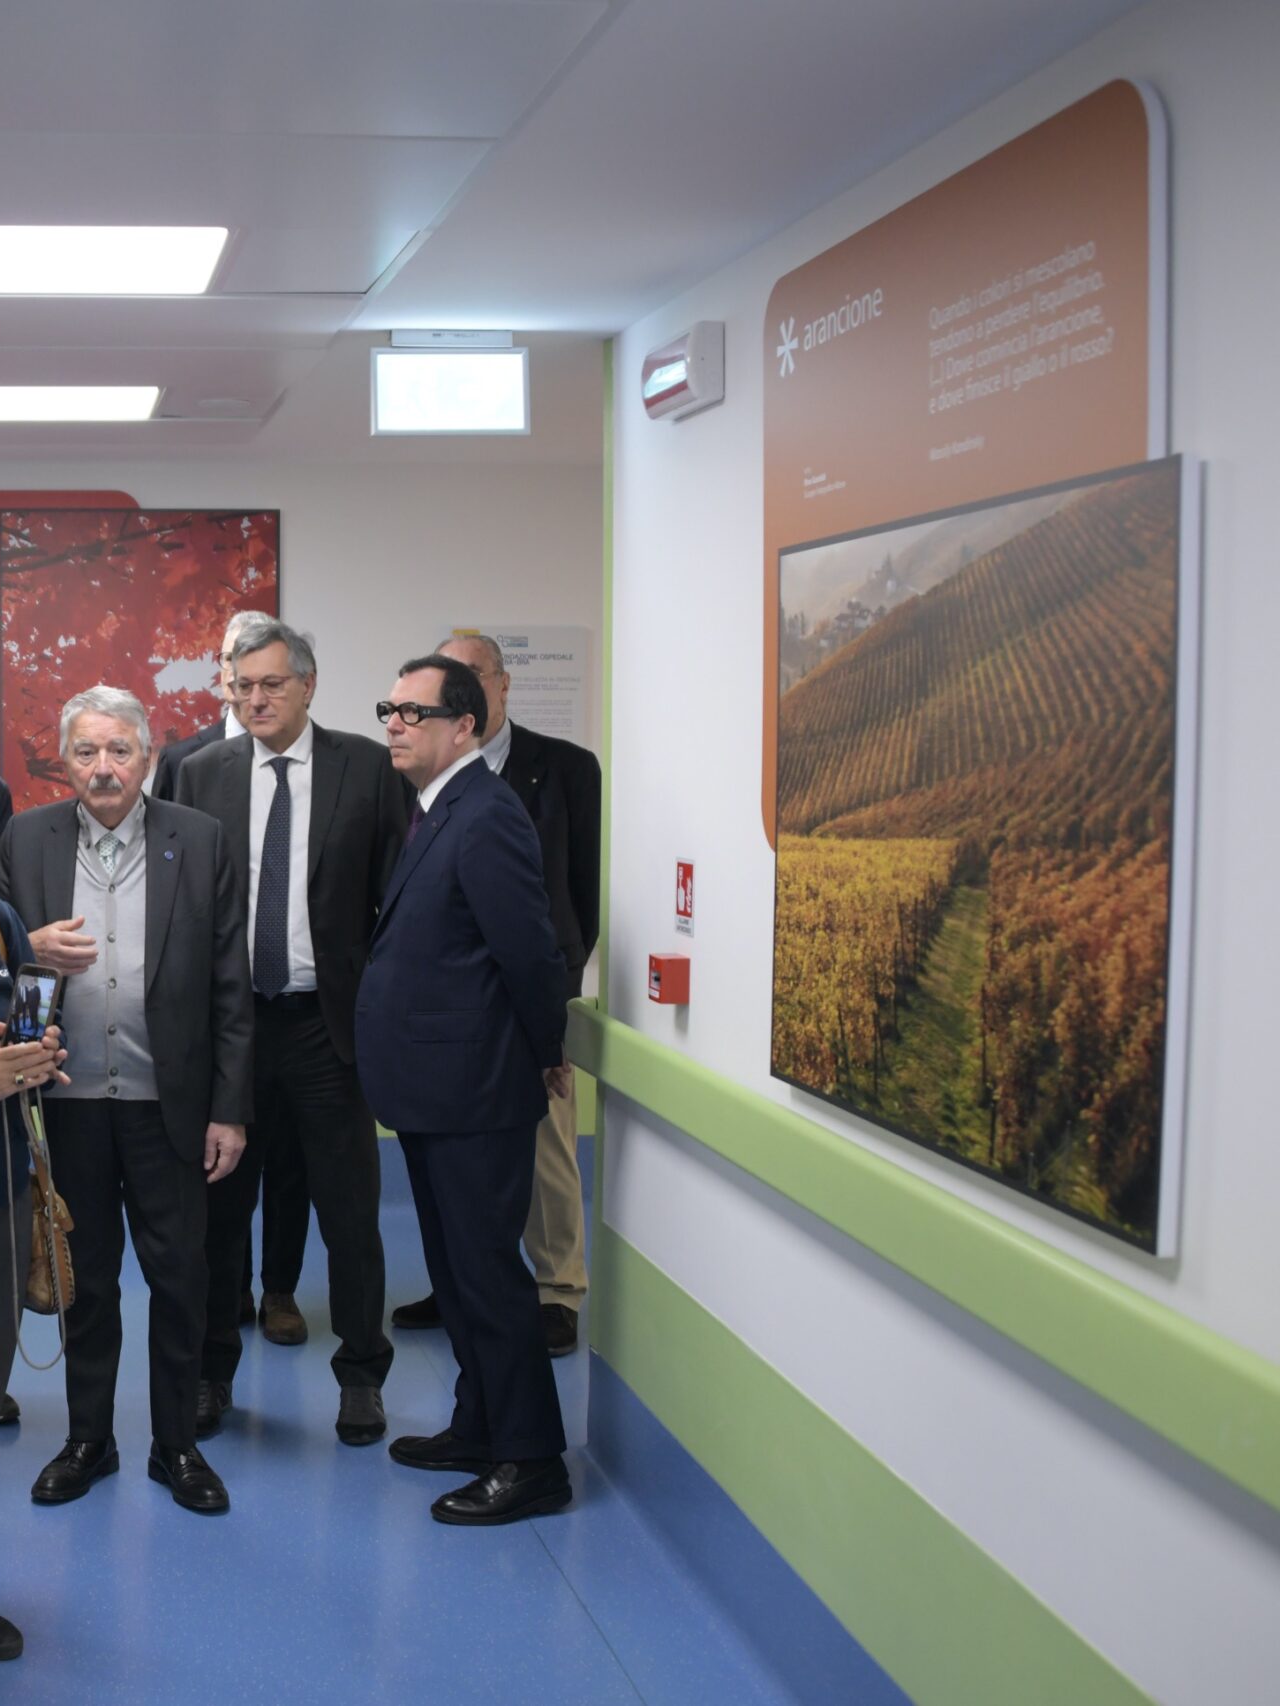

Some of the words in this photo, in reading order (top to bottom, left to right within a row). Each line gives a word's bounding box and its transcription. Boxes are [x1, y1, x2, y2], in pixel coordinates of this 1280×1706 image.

[928, 293, 971, 331] Quando
[979, 273, 1011, 309] colori
[1013, 268, 1023, 294] si
[1024, 240, 1095, 288] mescolano
[803, 287, 884, 352] arancione
[928, 325, 974, 359] tendono
[976, 321, 984, 340] a
[985, 301, 1030, 342] perdere
[928, 397, 937, 416] e
[938, 387, 964, 412] dove
[966, 373, 1001, 401] finisce
[1012, 353, 1047, 392] giallo
[1070, 326, 1115, 365] rosso?
[946, 356, 973, 381] Dove
[976, 331, 1029, 369] comincia
